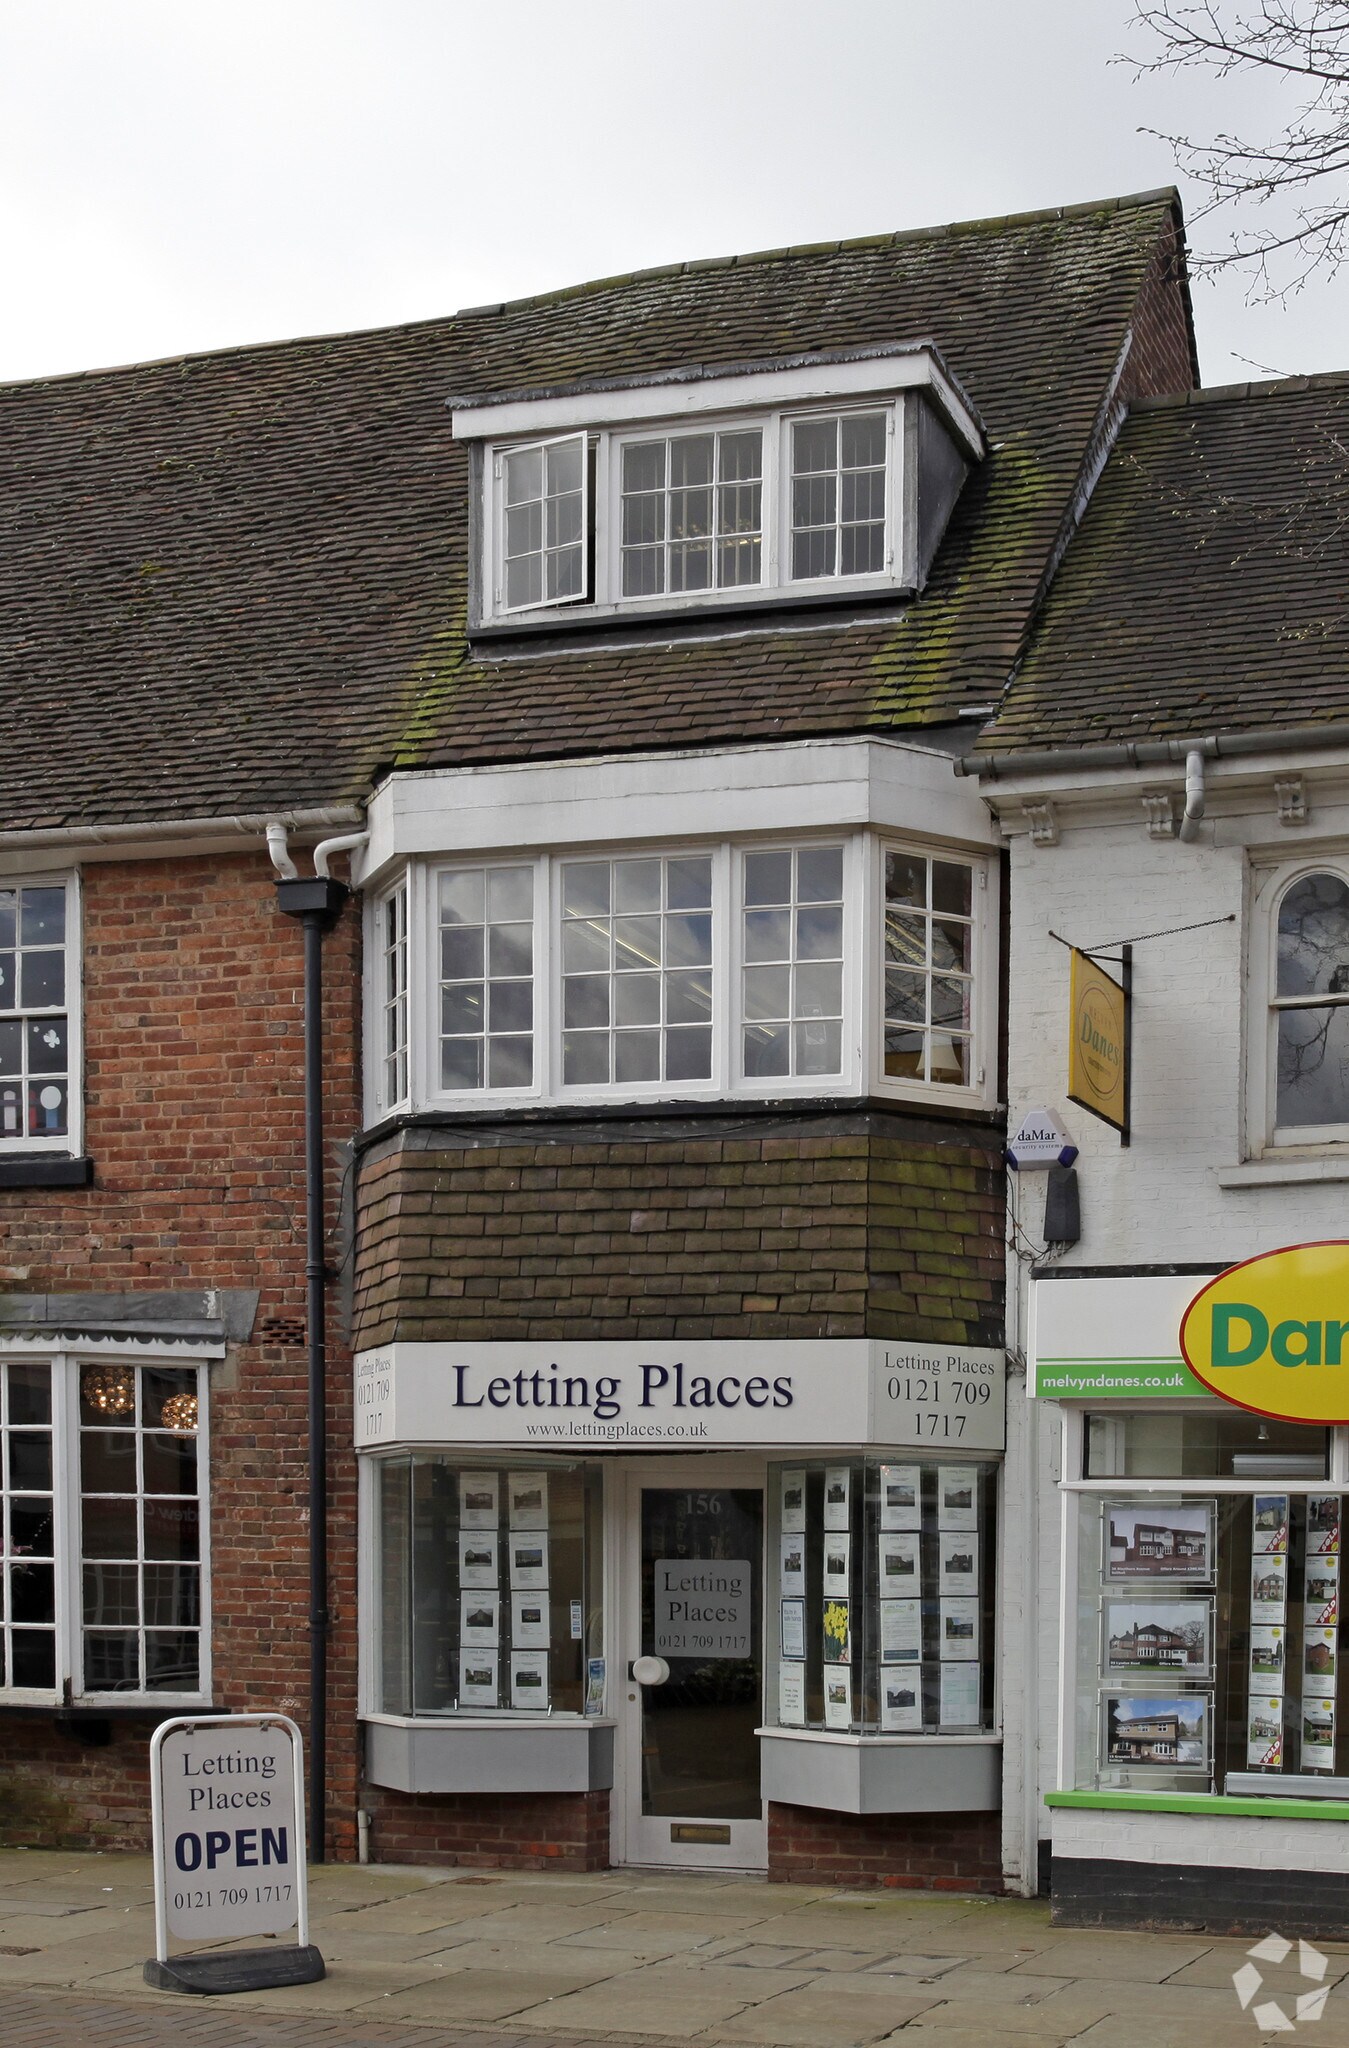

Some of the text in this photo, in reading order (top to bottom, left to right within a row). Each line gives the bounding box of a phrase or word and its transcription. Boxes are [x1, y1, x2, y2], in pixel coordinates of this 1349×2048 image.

[1080, 1011, 1120, 1066] Danes
[1017, 1129, 1056, 1141] daMar
[357, 1358, 391, 1378] Letting Places
[884, 1352, 995, 1376] Letting Places
[358, 1379, 390, 1405] 0121 709
[451, 1362, 795, 1420] Letting Places
[887, 1377, 991, 1405] 0121 709
[1042, 1373, 1184, 1391] melvyndanes.co.uk
[366, 1412, 383, 1436] 1717
[526, 1421, 708, 1440] www.lettingplaces.co.uk
[915, 1413, 967, 1437] 1717
[686, 1494, 722, 1515] 156
[1268, 1526, 1286, 1551] SOLD
[1321, 1527, 1338, 1552] SOLD
[663, 1572, 743, 1598] Letting
[668, 1601, 738, 1622] Places
[1320, 1599, 1336, 1624] SOLD
[659, 1634, 747, 1649] 0121 709 1717
[1263, 1740, 1280, 1764] SOLD
[182, 1750, 277, 1779] Letting
[188, 1787, 271, 1811] Places
[174, 1827, 288, 1872] OPEN
[174, 1885, 292, 1910] 0121 709 1717
